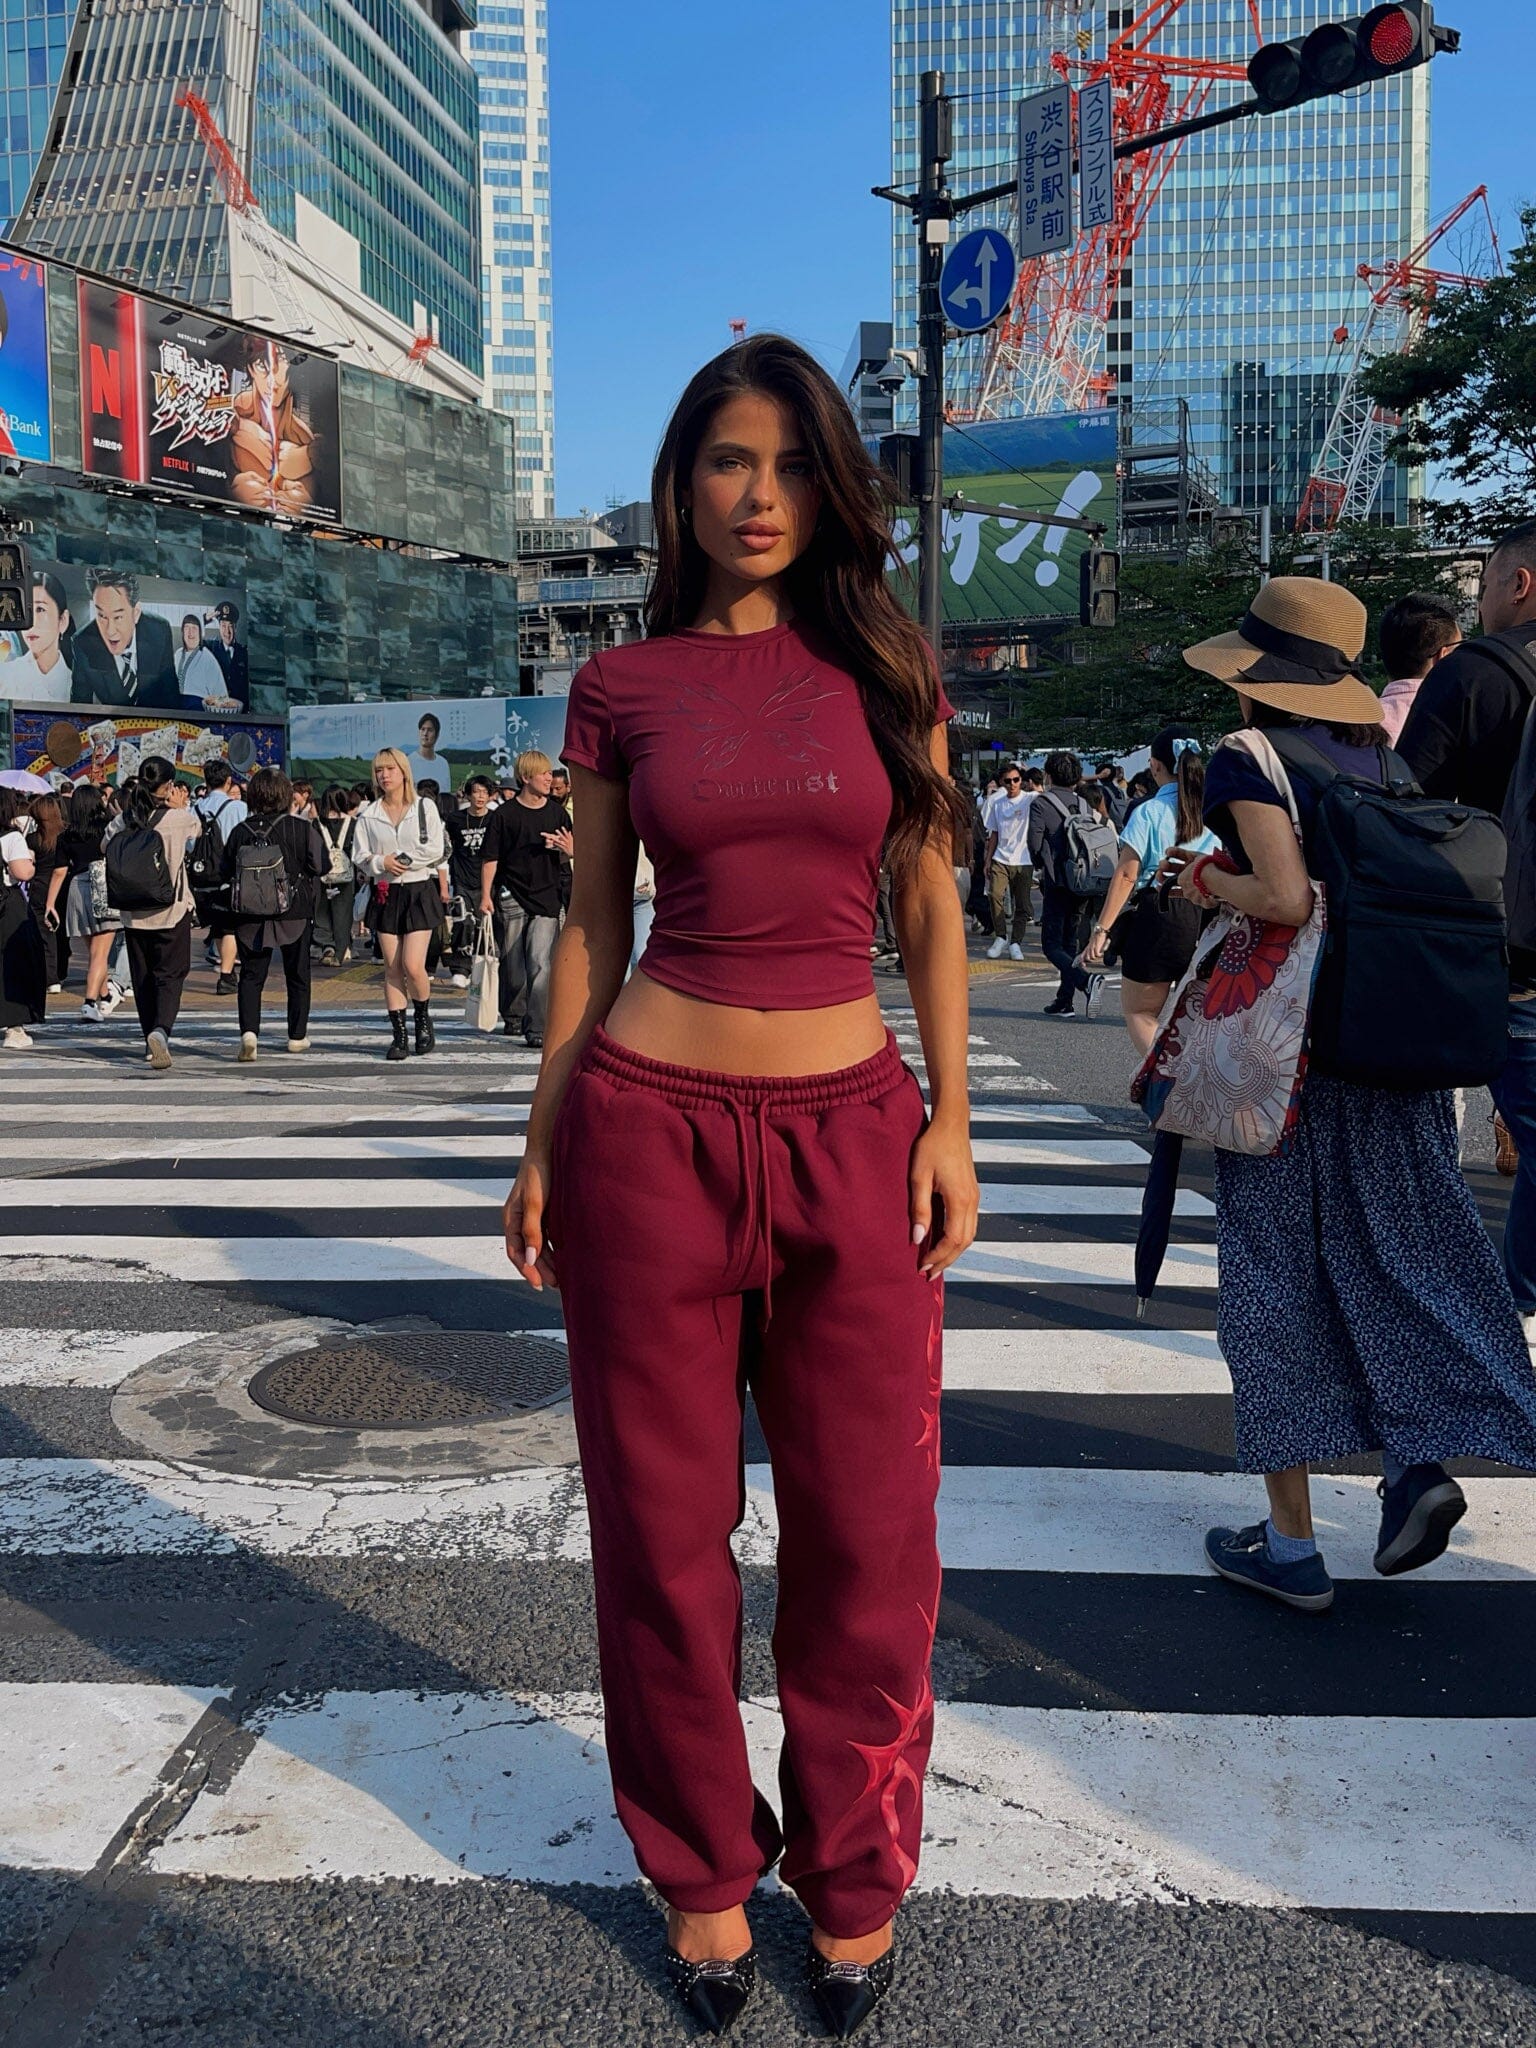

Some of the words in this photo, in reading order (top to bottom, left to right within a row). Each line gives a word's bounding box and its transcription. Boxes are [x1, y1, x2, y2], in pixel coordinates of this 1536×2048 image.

[1025, 130, 1037, 194] Shibuya
[1040, 101, 1064, 241] 渋谷駅前
[1087, 89, 1106, 223] スクランブル式
[1025, 198, 1037, 231] Sta.
[90, 343, 121, 419] N
[162, 456, 190, 473] NETFLIX
